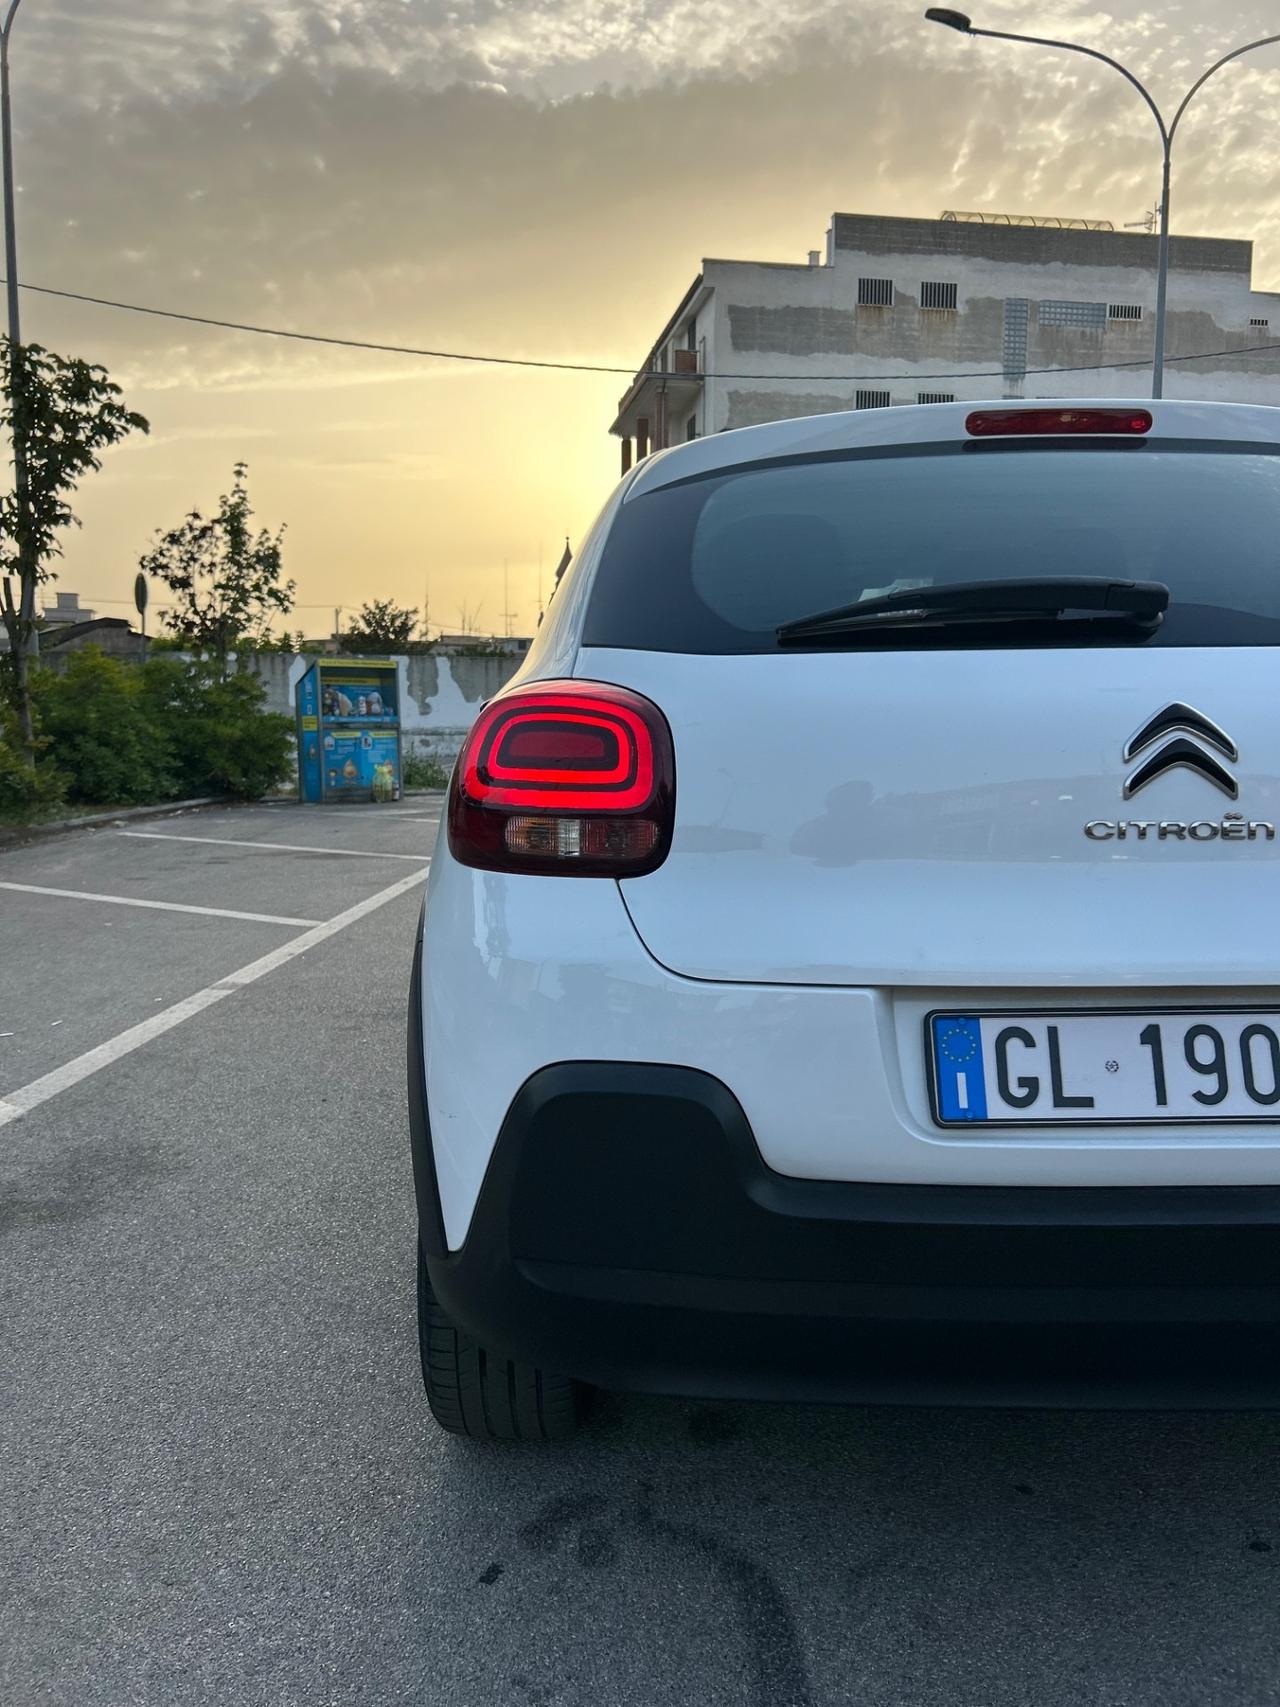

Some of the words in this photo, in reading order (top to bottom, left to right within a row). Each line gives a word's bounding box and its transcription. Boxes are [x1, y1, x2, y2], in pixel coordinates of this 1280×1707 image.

[956, 1071, 969, 1110] I
[994, 1025, 1095, 1109] GL
[1139, 1023, 1280, 1106] 190
